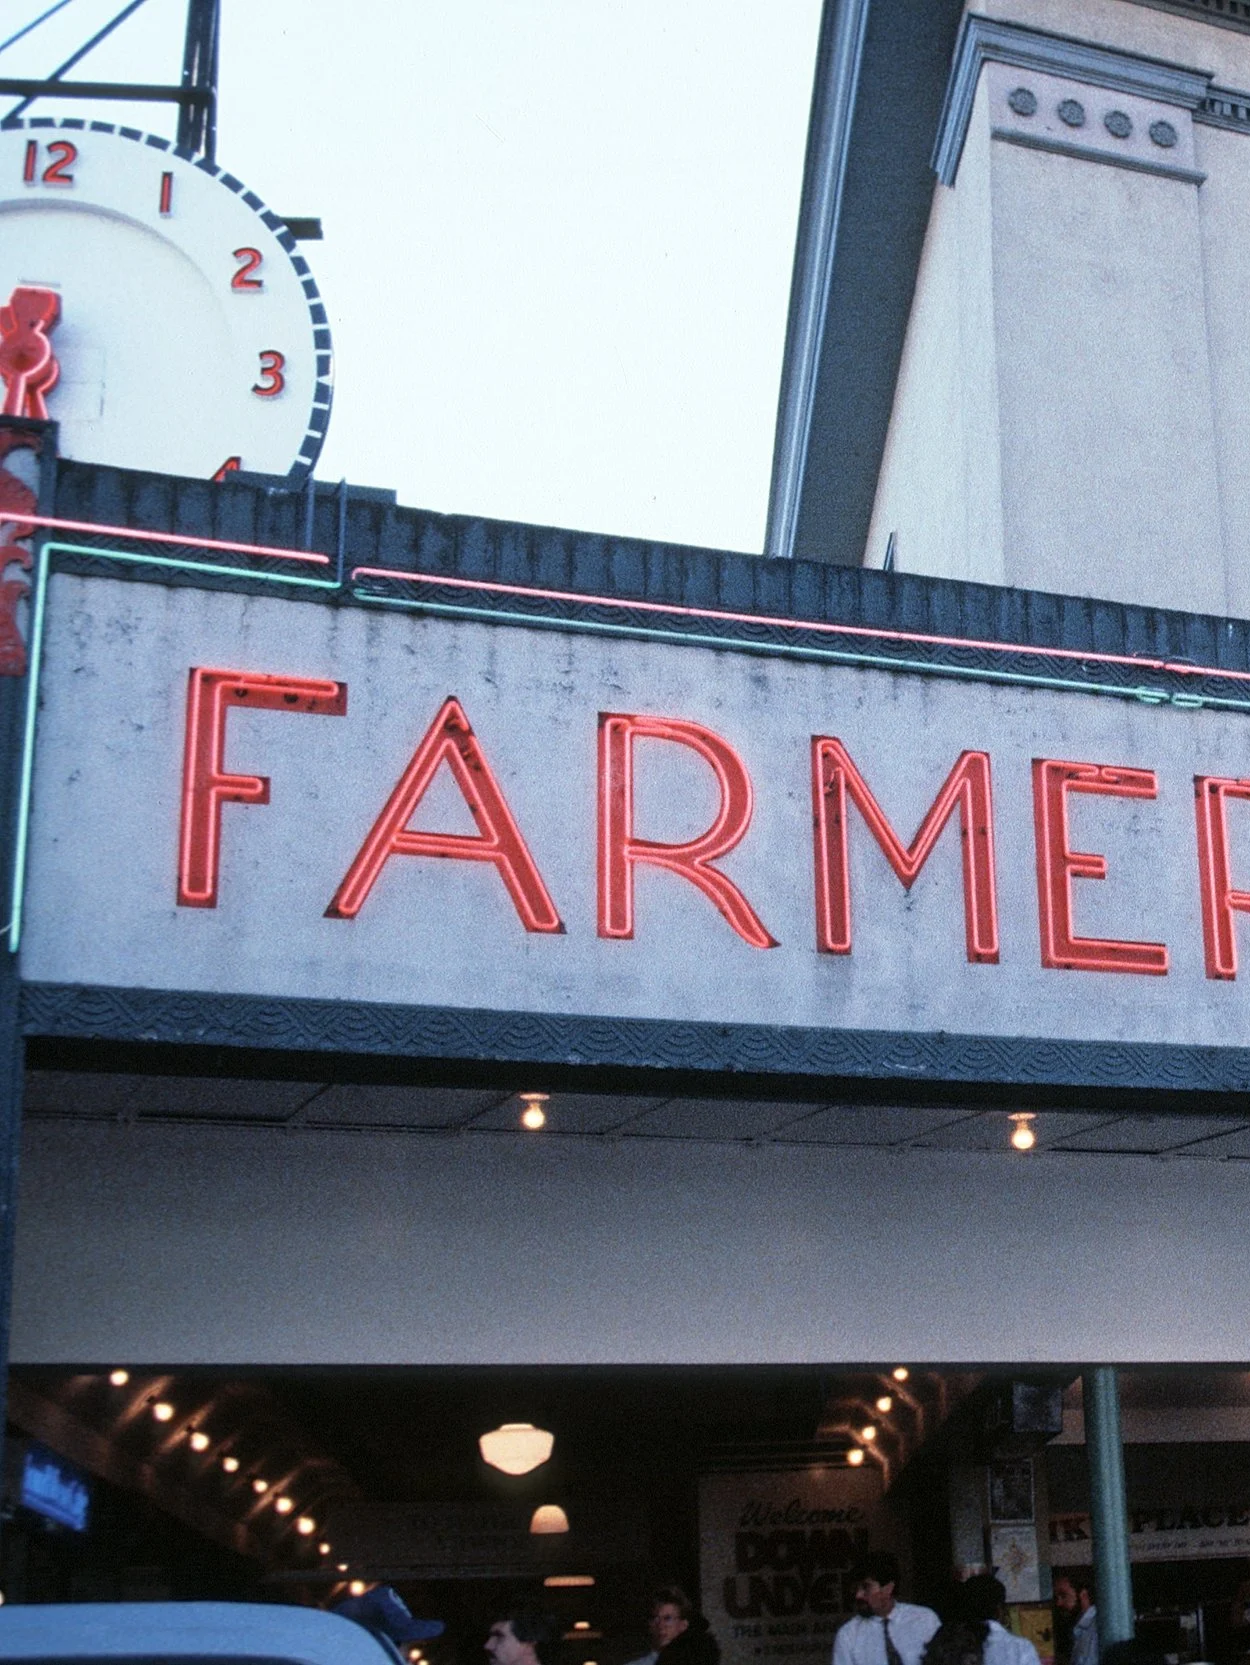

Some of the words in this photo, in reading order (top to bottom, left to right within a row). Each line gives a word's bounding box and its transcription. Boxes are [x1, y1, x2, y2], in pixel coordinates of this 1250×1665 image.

[23, 140, 78, 184] 12
[159, 172, 174, 214] 1
[231, 247, 265, 290] 2
[252, 350, 286, 397] 3
[1131, 1505, 1250, 1533] PLACE
[722, 1573, 855, 1619] UNDE
